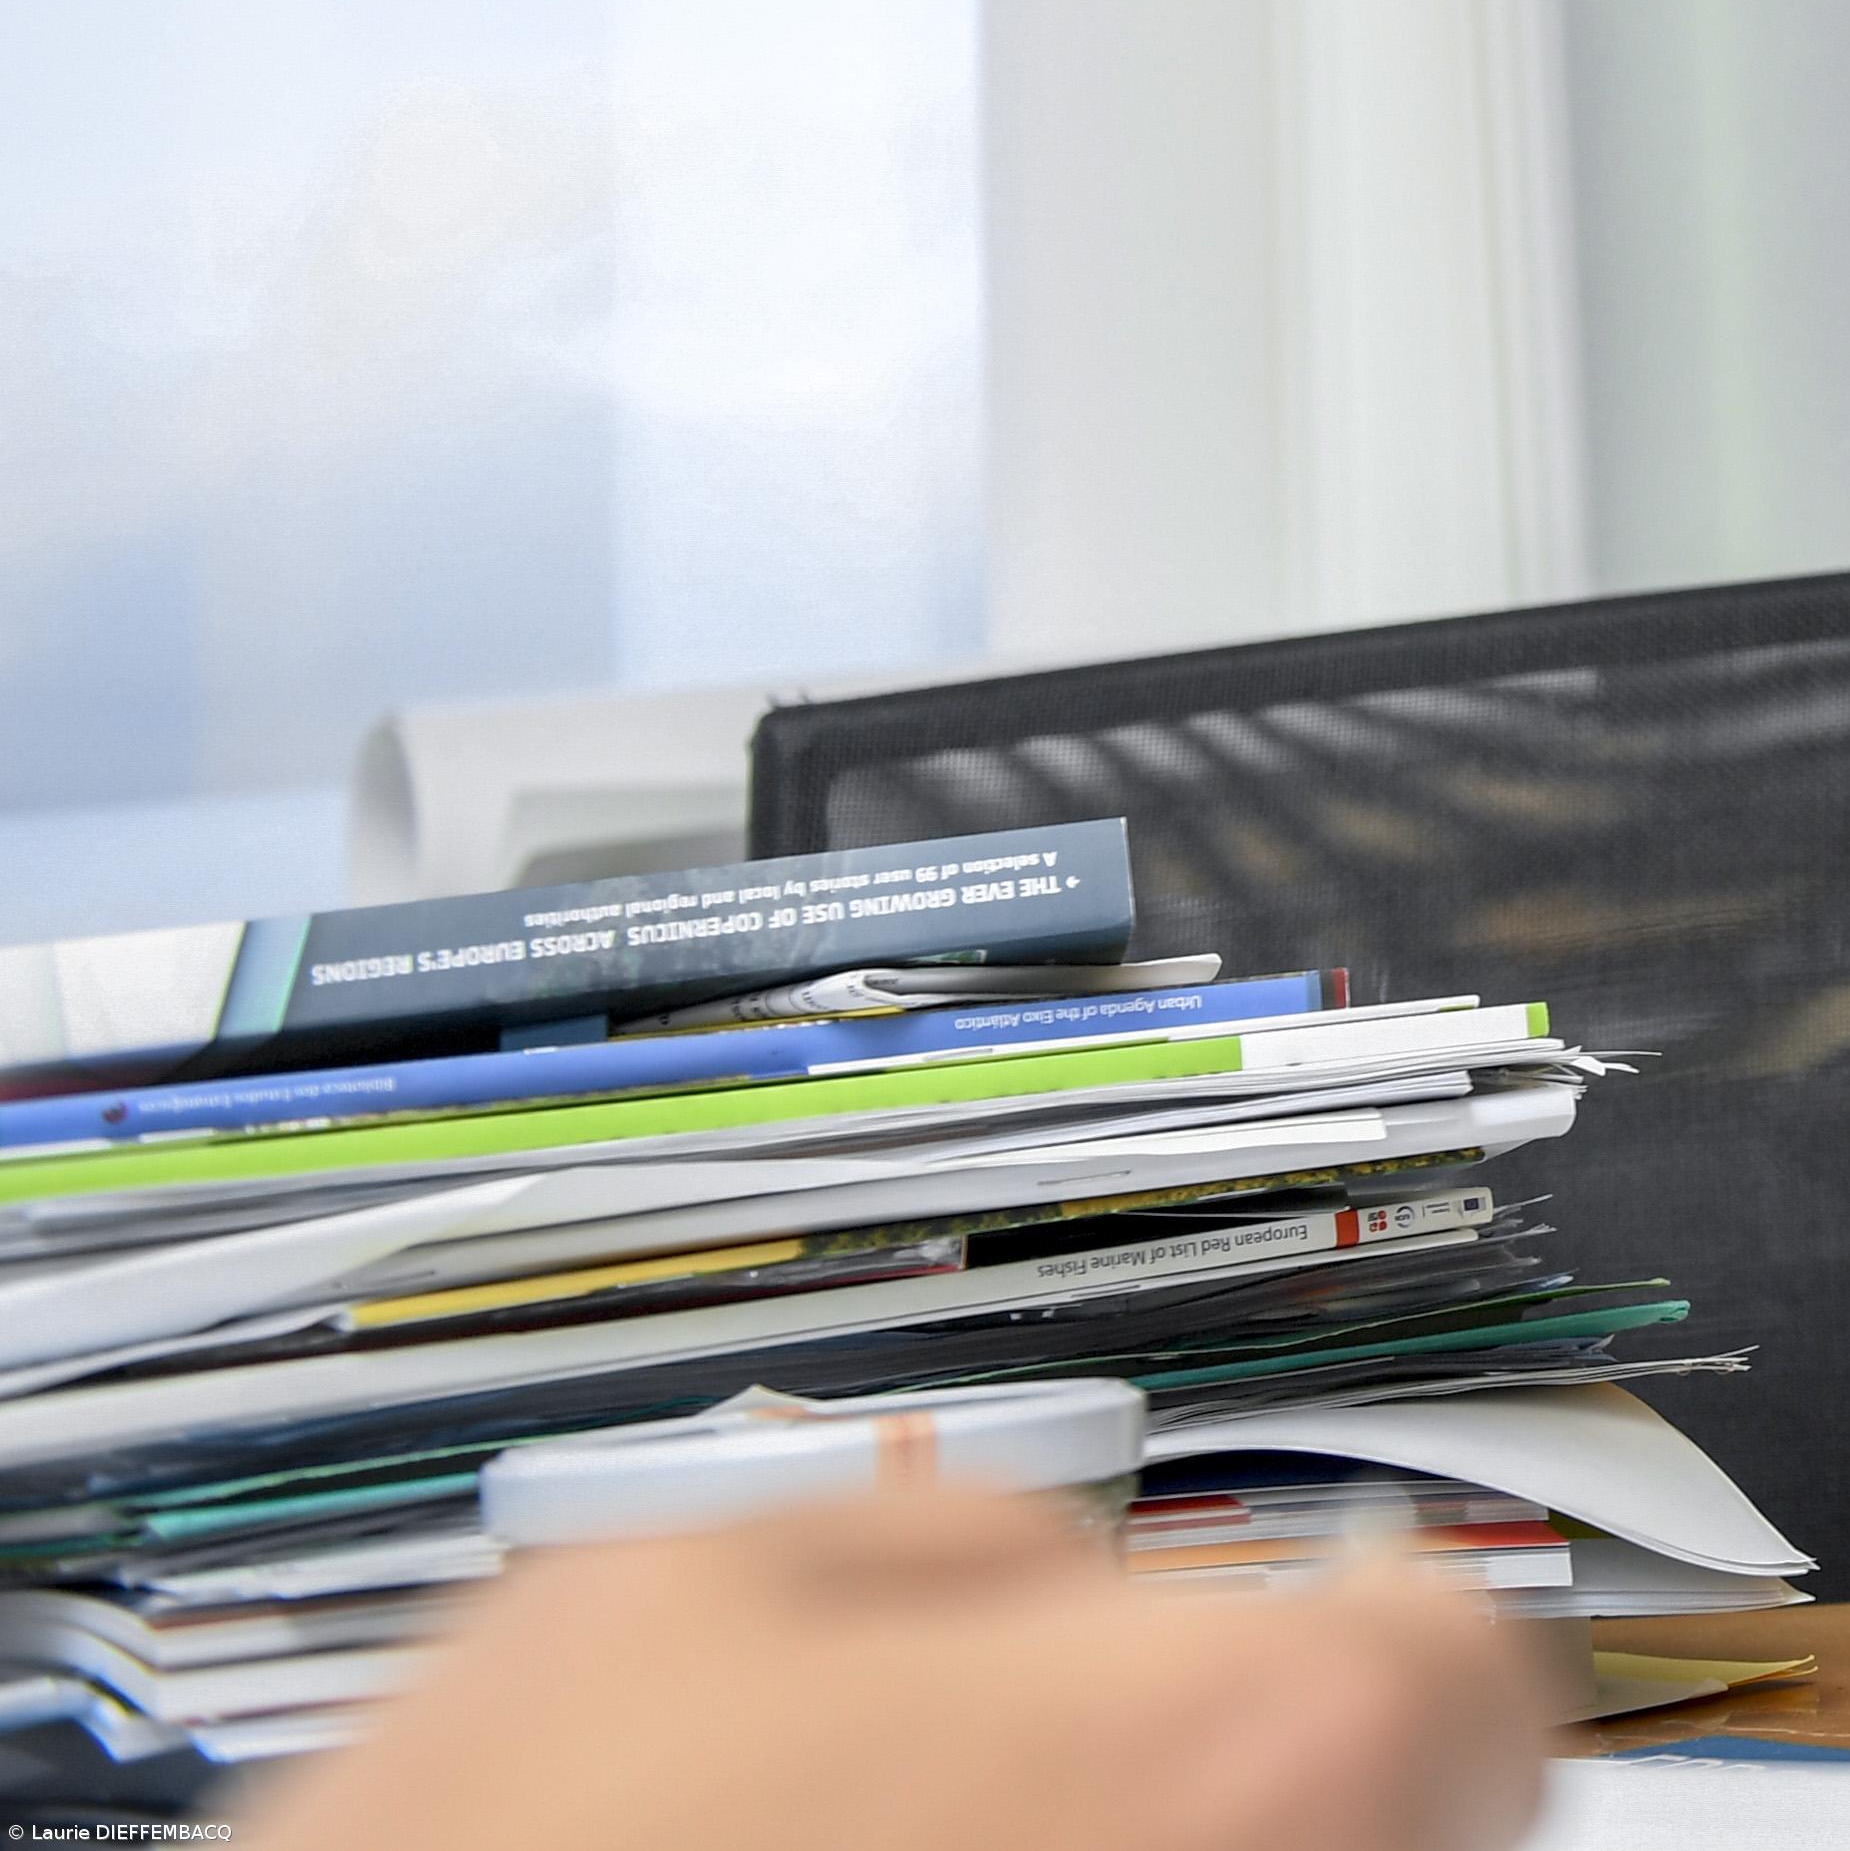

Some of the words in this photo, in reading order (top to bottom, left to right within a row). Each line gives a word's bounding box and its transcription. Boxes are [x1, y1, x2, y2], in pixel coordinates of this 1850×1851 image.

[963, 853, 1040, 874] selection
[1042, 851, 1058, 866] A
[874, 869, 913, 885] user
[916, 865, 938, 883] 99
[940, 863, 959, 881] of
[784, 880, 807, 898] by
[809, 873, 871, 893] stories
[961, 880, 1015, 903] EVER
[1019, 875, 1061, 897] THE
[703, 891, 735, 908] and
[739, 884, 781, 903] local
[849, 887, 956, 919] GROWING
[626, 893, 698, 917] regional
[802, 902, 845, 923] USE
[524, 904, 623, 927] authorities
[768, 908, 797, 928] OF
[627, 912, 763, 946] COPERNICUS
[530, 930, 616, 958] ACROSS
[418, 940, 526, 972] EUROPE'S
[312, 955, 413, 985] REGIONS
[1100, 998, 1155, 1016] Agenda
[1158, 995, 1202, 1011] Urban
[955, 1013, 1021, 1031] Atlántico
[1022, 1009, 1054, 1026] Eixo
[1056, 1007, 1079, 1022] the
[1080, 1006, 1098, 1021] of
[233, 1087, 291, 1106] Estudos
[322, 1077, 395, 1098] Biblioteca
[1199, 1236, 1231, 1255] Red
[1234, 1224, 1308, 1247] European
[1090, 1248, 1146, 1271] Marine
[1149, 1246, 1166, 1264] of
[1170, 1240, 1196, 1260] List
[1037, 1256, 1087, 1280] Fishes
